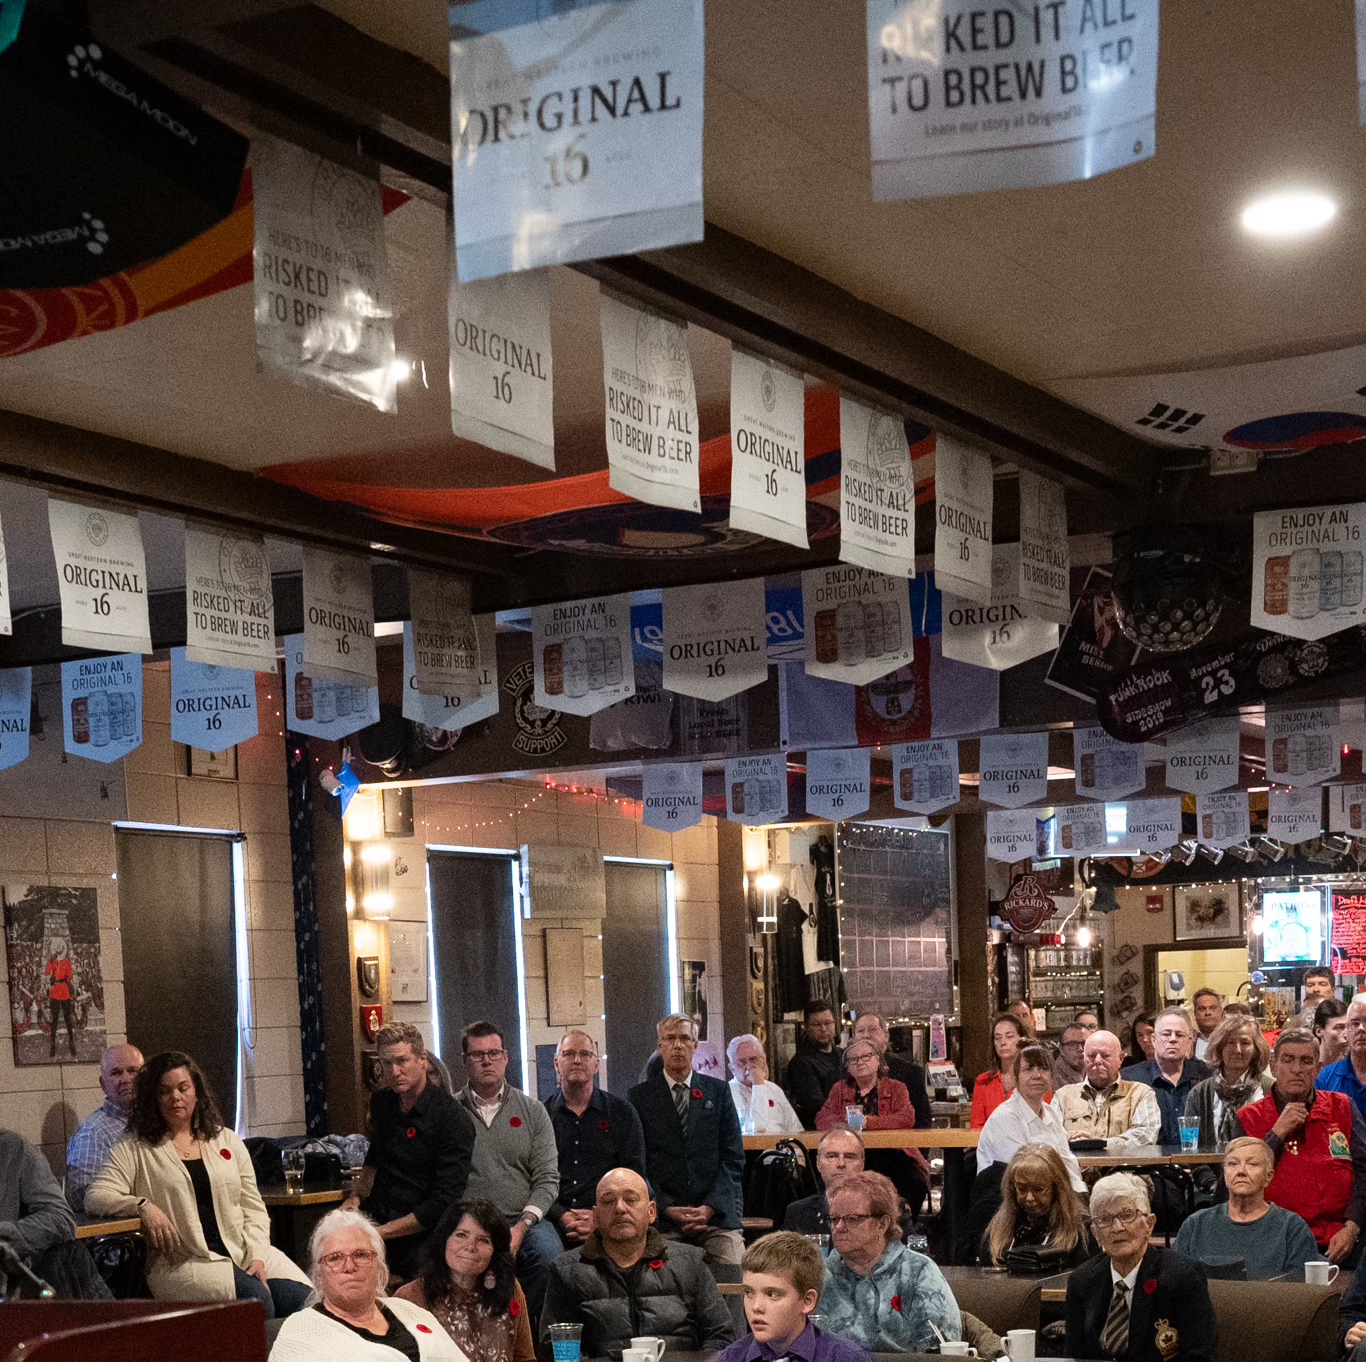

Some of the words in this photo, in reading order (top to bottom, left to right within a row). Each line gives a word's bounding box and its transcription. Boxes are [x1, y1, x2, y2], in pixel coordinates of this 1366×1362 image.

[882, 74, 931, 114] TO
[943, 58, 1046, 109] BREW
[83, 62, 138, 106] MEGA
[139, 99, 199, 146] MOON
[454, 318, 547, 381] ORIGINAL
[492, 371, 513, 404] 16
[608, 386, 644, 423] RISKED
[647, 402, 661, 425] IT
[667, 407, 692, 435] ALL
[736, 428, 802, 475] ORIGINAL
[938, 503, 990, 542] ORIGINAL
[1281, 512, 1325, 530] ENJOY
[1329, 510, 1349, 526] AN
[959, 536, 971, 561] 16
[1268, 529, 1340, 548] ORIGINAL
[1344, 526, 1361, 541] 16
[63, 563, 143, 594] ORIGINAL
[92, 591, 111, 617] 16
[193, 611, 208, 631] TO
[210, 614, 239, 636] BREW
[242, 620, 270, 641] BEER
[308, 605, 373, 639] ORIGINAL
[669, 634, 761, 662] ORIGINAL
[1079, 640, 1101, 657] MISS
[705, 657, 727, 679] 16
[1189, 650, 1235, 681] November
[1109, 680, 1136, 704] PUNK
[1200, 668, 1236, 705] 23
[175, 693, 251, 714] ORIGINAL
[1125, 697, 1173, 725] SIDESHOW
[688, 720, 714, 730] Local
[1139, 713, 1165, 734] 2019
[514, 729, 568, 753] SUPPORT
[1170, 753, 1235, 768] ORIGINAL
[983, 767, 1044, 782] ORIGINAL
[809, 782, 866, 796] ORIGINAL
[645, 794, 699, 809] ORIGINAL
[1129, 822, 1176, 835] ORIGINAL
[1270, 813, 1319, 825] ORIGINAL
[989, 832, 1034, 844] ORIGINAL
[1003, 898, 1050, 911] RICKARD'S
